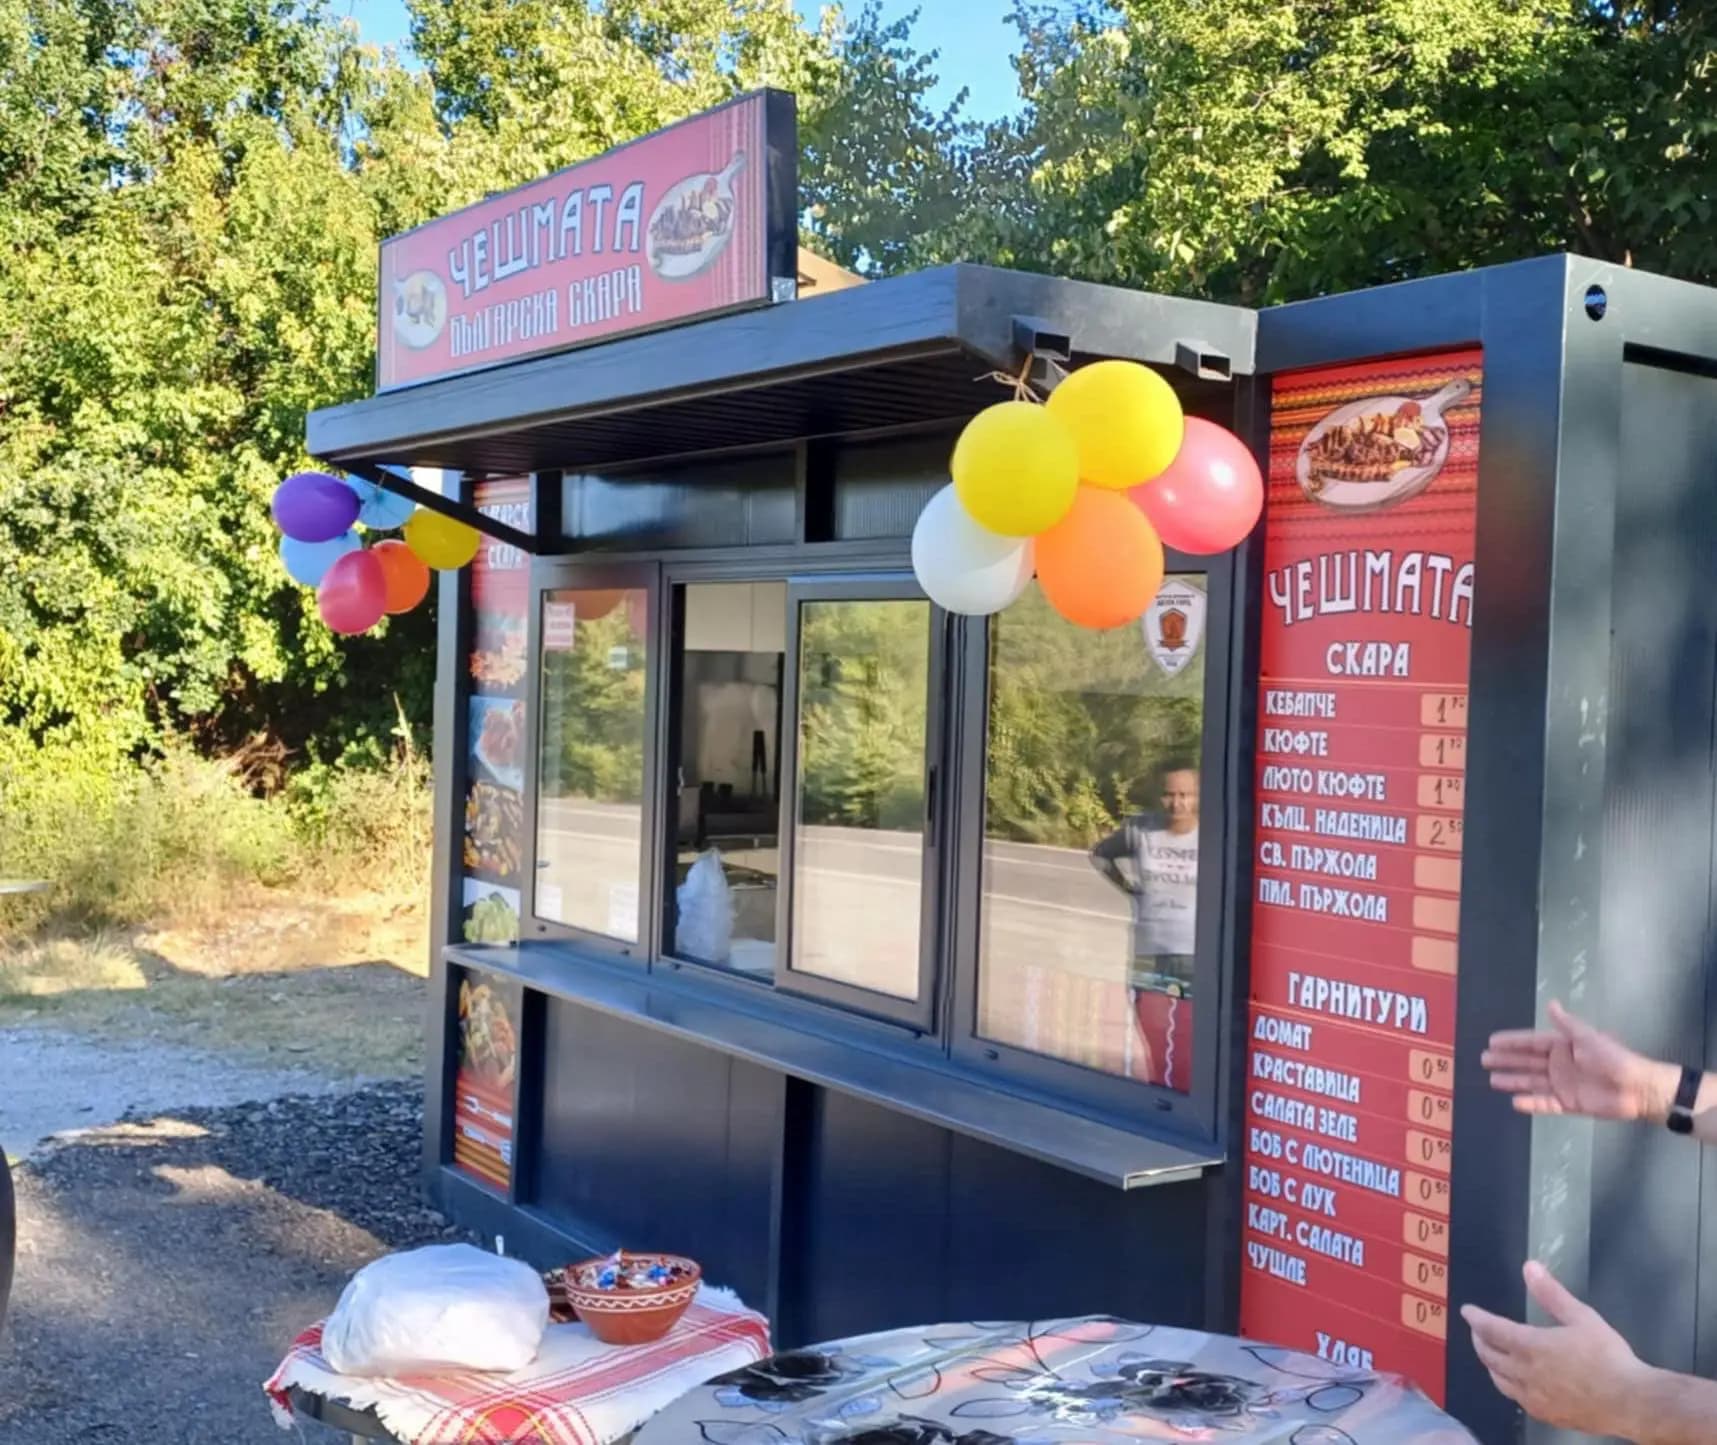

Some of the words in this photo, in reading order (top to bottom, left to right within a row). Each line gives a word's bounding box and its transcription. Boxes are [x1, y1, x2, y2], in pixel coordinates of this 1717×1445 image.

[448, 181, 645, 299] ЧЕШМАТА
[449, 287, 558, 358] БЪЛГАРСКА
[569, 264, 642, 327] СКАРА
[1269, 550, 1475, 627] ЧЕШМАТА
[1326, 642, 1410, 676] СКАРА
[1265, 690, 1337, 718] КЕБАПЧЕ
[1264, 728, 1329, 756] КЮФТЕ
[1263, 765, 1313, 791] ЛЮТО
[1317, 770, 1386, 800] КЮФТЕ
[1262, 803, 1311, 832] КЪЛЦ.
[1315, 809, 1407, 843] НАДЕНИЦА
[1260, 841, 1287, 868] СВ.
[1291, 844, 1377, 880] ПЪРЖОЛА
[1259, 877, 1296, 906] ПИЛ.
[1300, 883, 1387, 922] ПЪРЖОЛА
[1288, 971, 1428, 1034] ГАРНИТУРИ
[1254, 1015, 1313, 1051] ДОМАТ
[1253, 1051, 1361, 1104] КРАСТАВИЦА
[1251, 1091, 1315, 1131] САЛАТА
[1318, 1107, 1358, 1143] ЗЕЛЕ
[1250, 1127, 1282, 1158] БОБ
[1285, 1139, 1298, 1164] С
[1302, 1143, 1401, 1197] ЛЮТЕНИЦА
[1249, 1165, 1281, 1198] БОБ
[1284, 1178, 1297, 1203] С
[1301, 1183, 1337, 1217] ЛУК
[1248, 1202, 1292, 1241] КАРТ.
[1296, 1221, 1364, 1267] САЛАТА
[1247, 1240, 1307, 1286] ЧУШЛЕ
